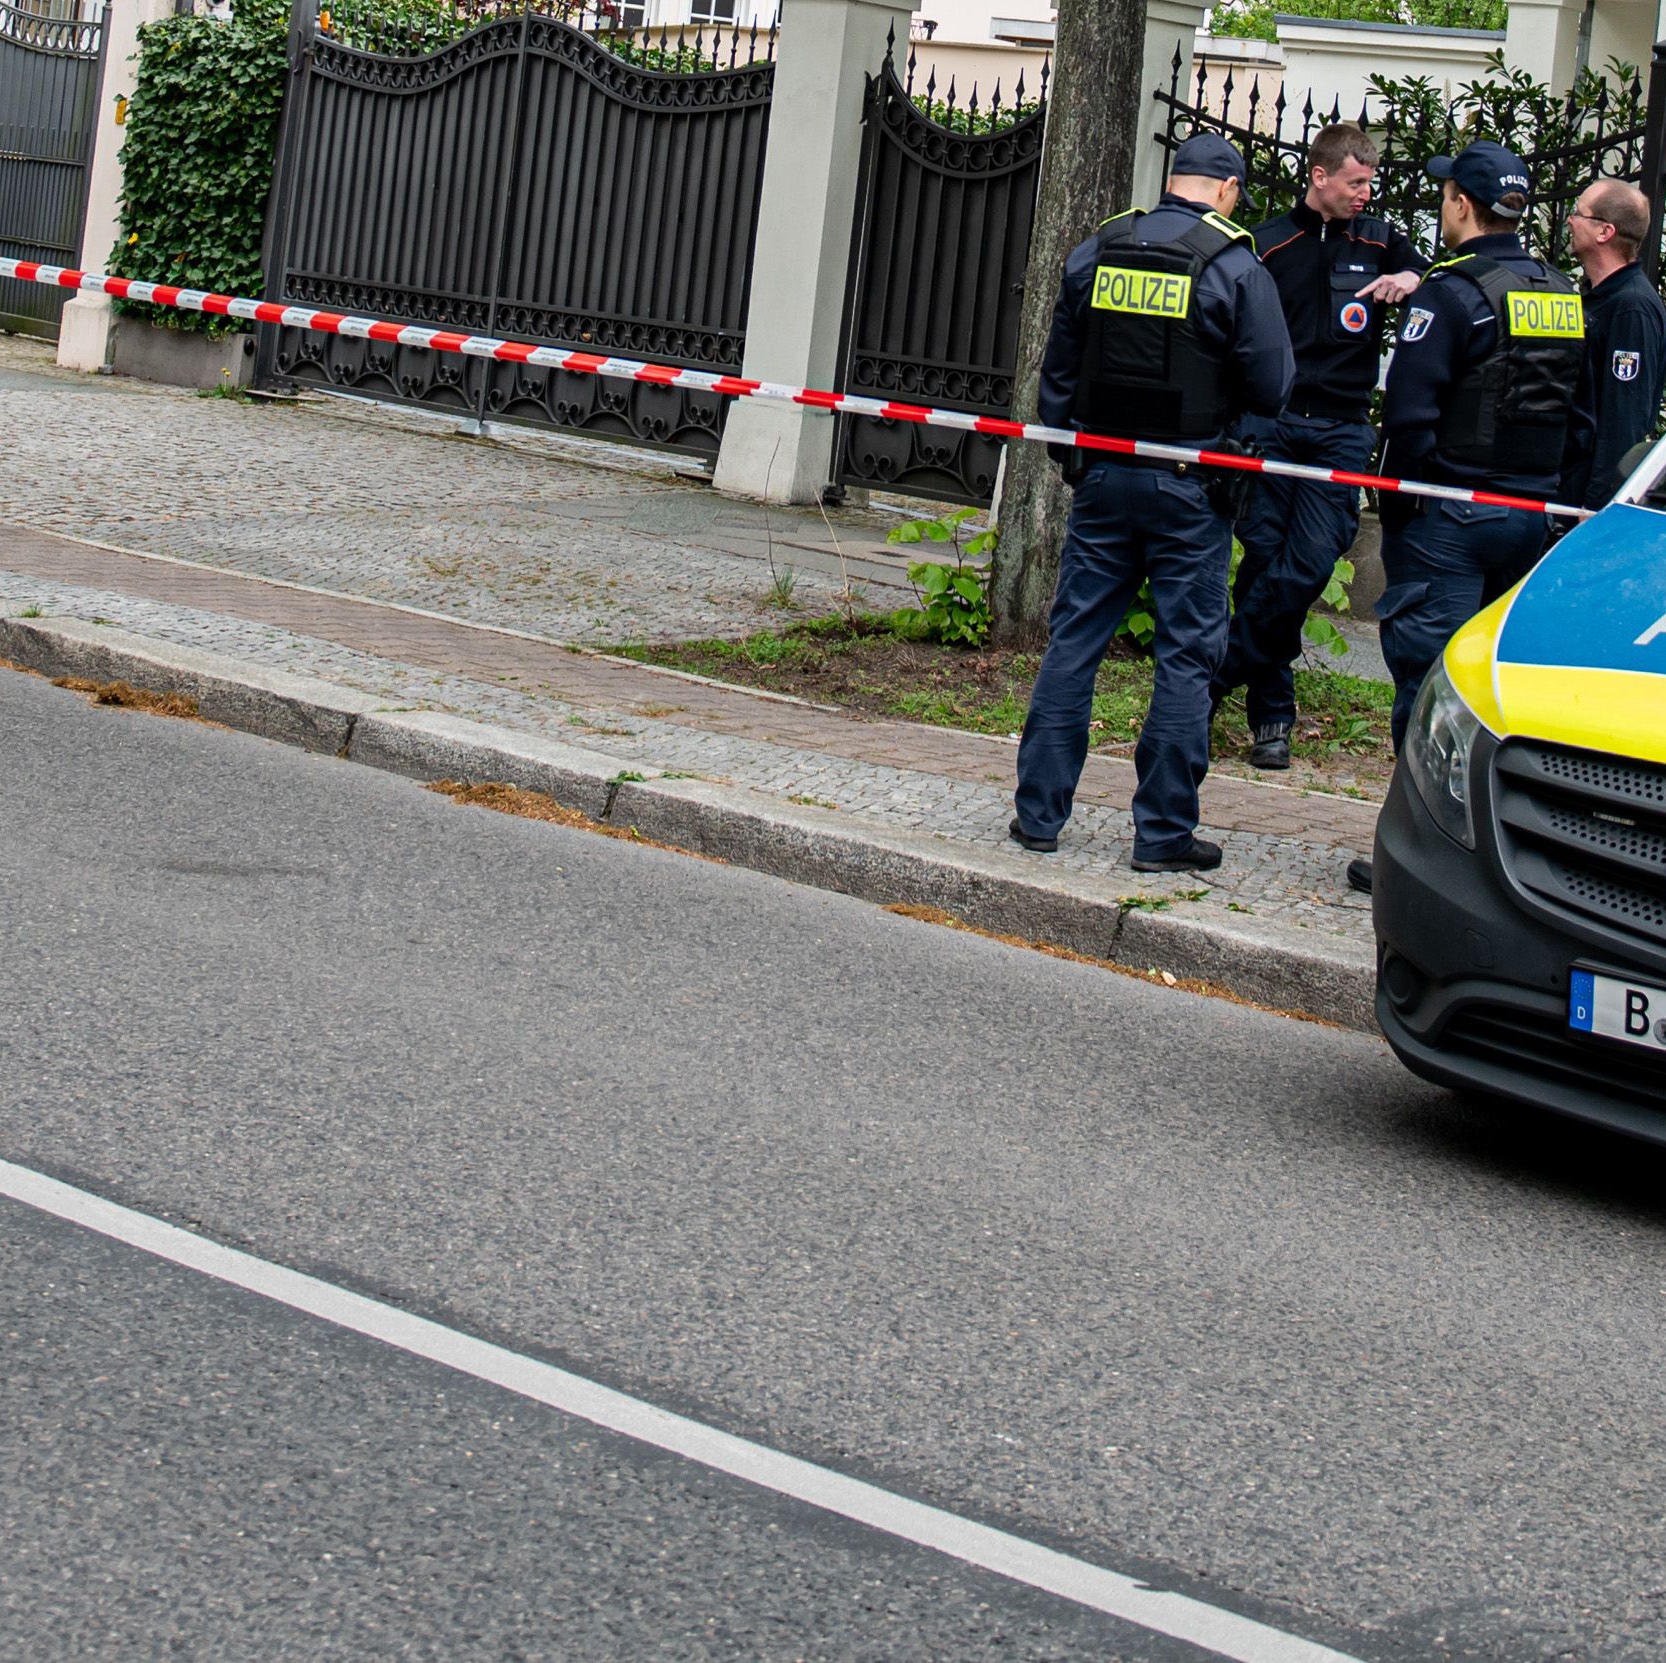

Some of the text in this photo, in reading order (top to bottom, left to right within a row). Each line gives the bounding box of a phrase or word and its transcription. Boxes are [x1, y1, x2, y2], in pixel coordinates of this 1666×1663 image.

[1096, 271, 1187, 314] POLIZEI
[1513, 299, 1580, 332] POLIZEI
[1576, 1005, 1586, 1020] D
[1625, 988, 1650, 1037] B
